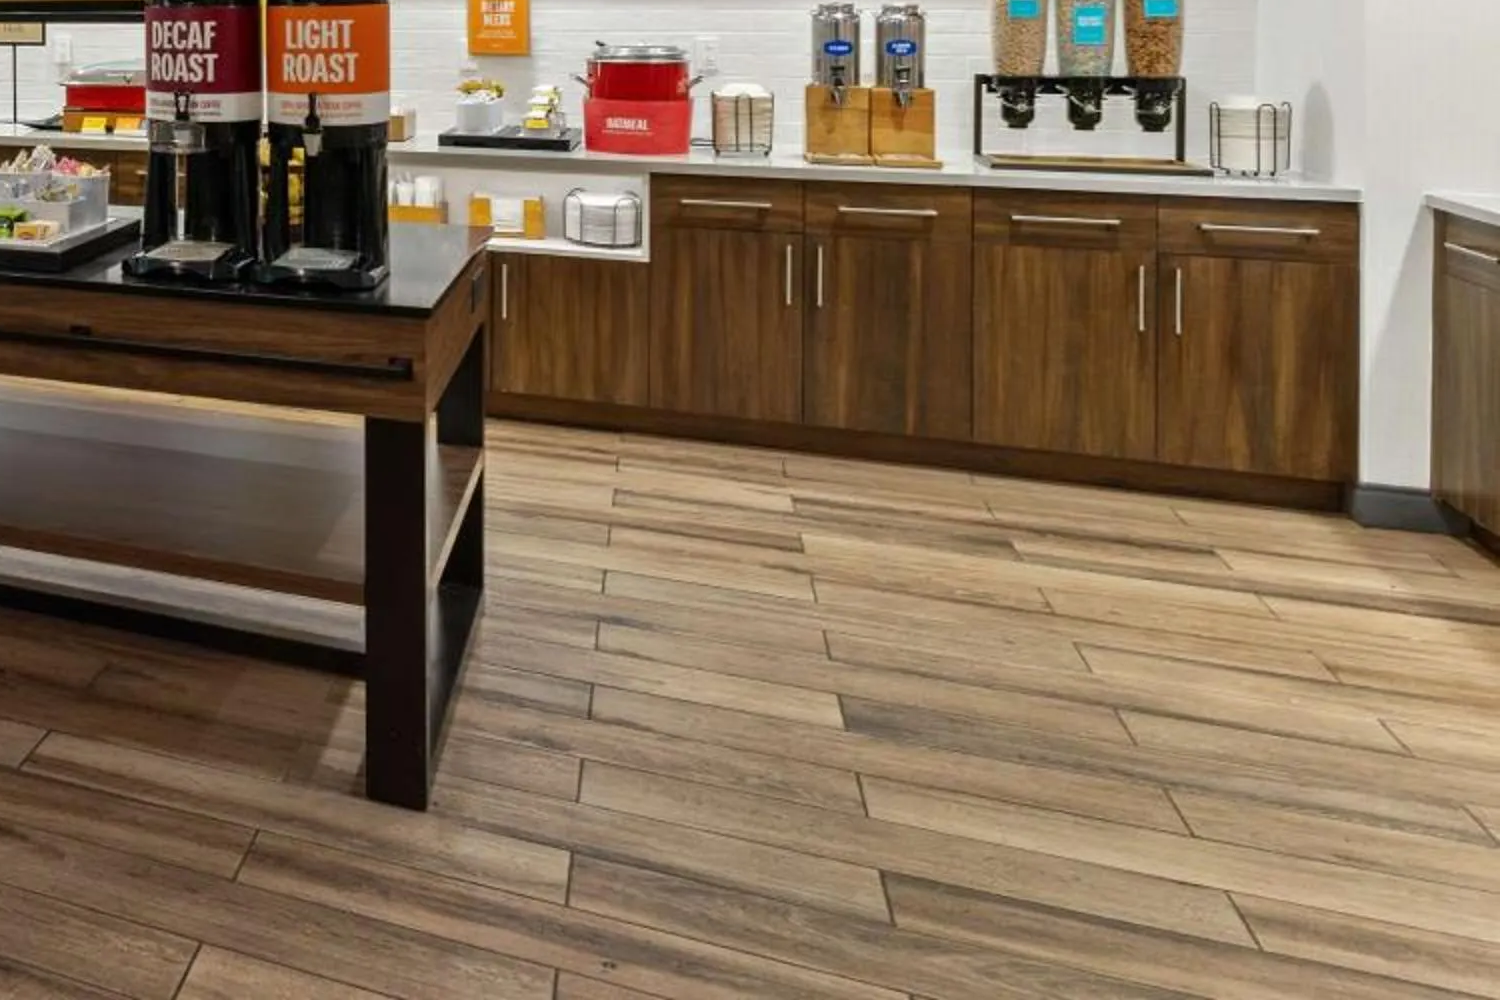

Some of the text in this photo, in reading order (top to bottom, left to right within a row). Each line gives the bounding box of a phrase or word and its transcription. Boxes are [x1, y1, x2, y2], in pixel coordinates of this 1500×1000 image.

[151, 20, 218, 50] DECAF
[285, 19, 355, 50] LIGHT
[151, 53, 218, 84] ROAST
[282, 52, 360, 84] ROAST
